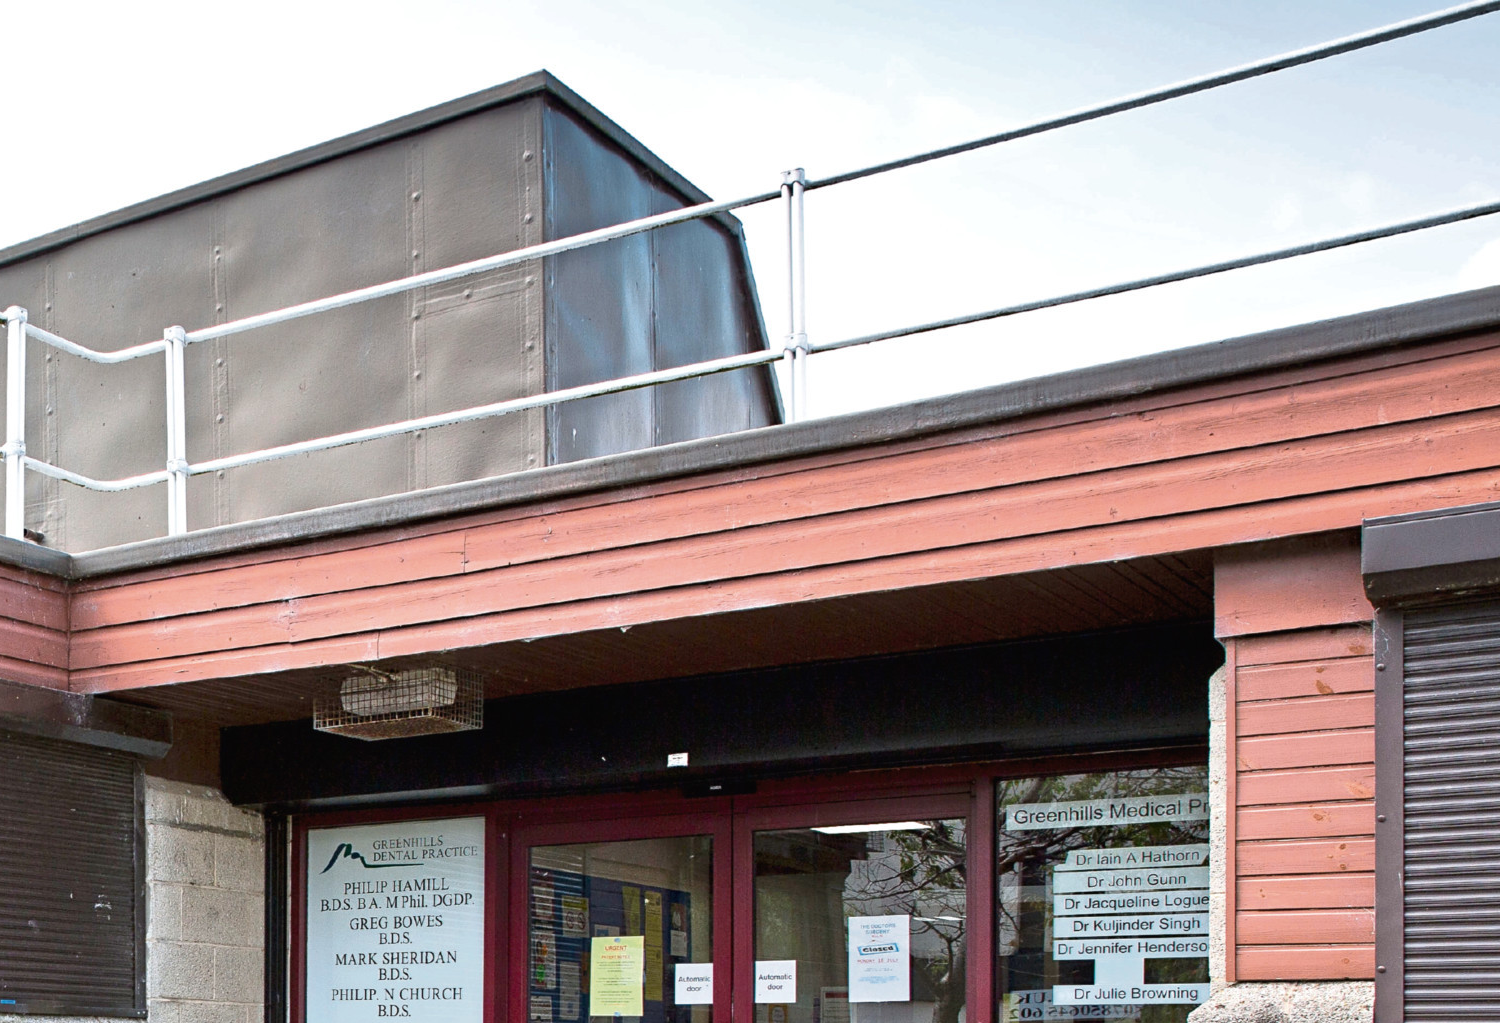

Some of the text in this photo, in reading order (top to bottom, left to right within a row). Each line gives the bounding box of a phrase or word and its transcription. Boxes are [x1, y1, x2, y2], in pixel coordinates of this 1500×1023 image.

[1014, 806, 1103, 824] Greenhills
[1110, 801, 1180, 818] Medical
[373, 835, 443, 850] GREENHILLS
[373, 846, 478, 862] DENTAL PRACTICE
[1076, 851, 1200, 865] Dr Iain A Hathorn
[344, 878, 449, 894] PHILIP HAMILL
[1088, 874, 1186, 887] Dr John Gunn
[321, 899, 352, 912] B.D.S.
[433, 893, 474, 907] DGDP.
[1065, 895, 1209, 910] Dr Jacqueline Logue
[350, 915, 442, 930] GREG BOWES
[1073, 918, 1200, 933] Dr Kuljinder Singh
[379, 932, 413, 944] B.D.S.
[1058, 944, 1073, 955] Dr
[1078, 943, 1132, 954] Jennifer
[335, 951, 457, 966] MARK SHERIDAN
[378, 968, 412, 980] B.D.S.
[385, 988, 395, 1000] N
[399, 988, 463, 1000] CHURCH
[1074, 988, 1198, 1000] Dr Julie Browning
[378, 1004, 411, 1017] B.D.S.
